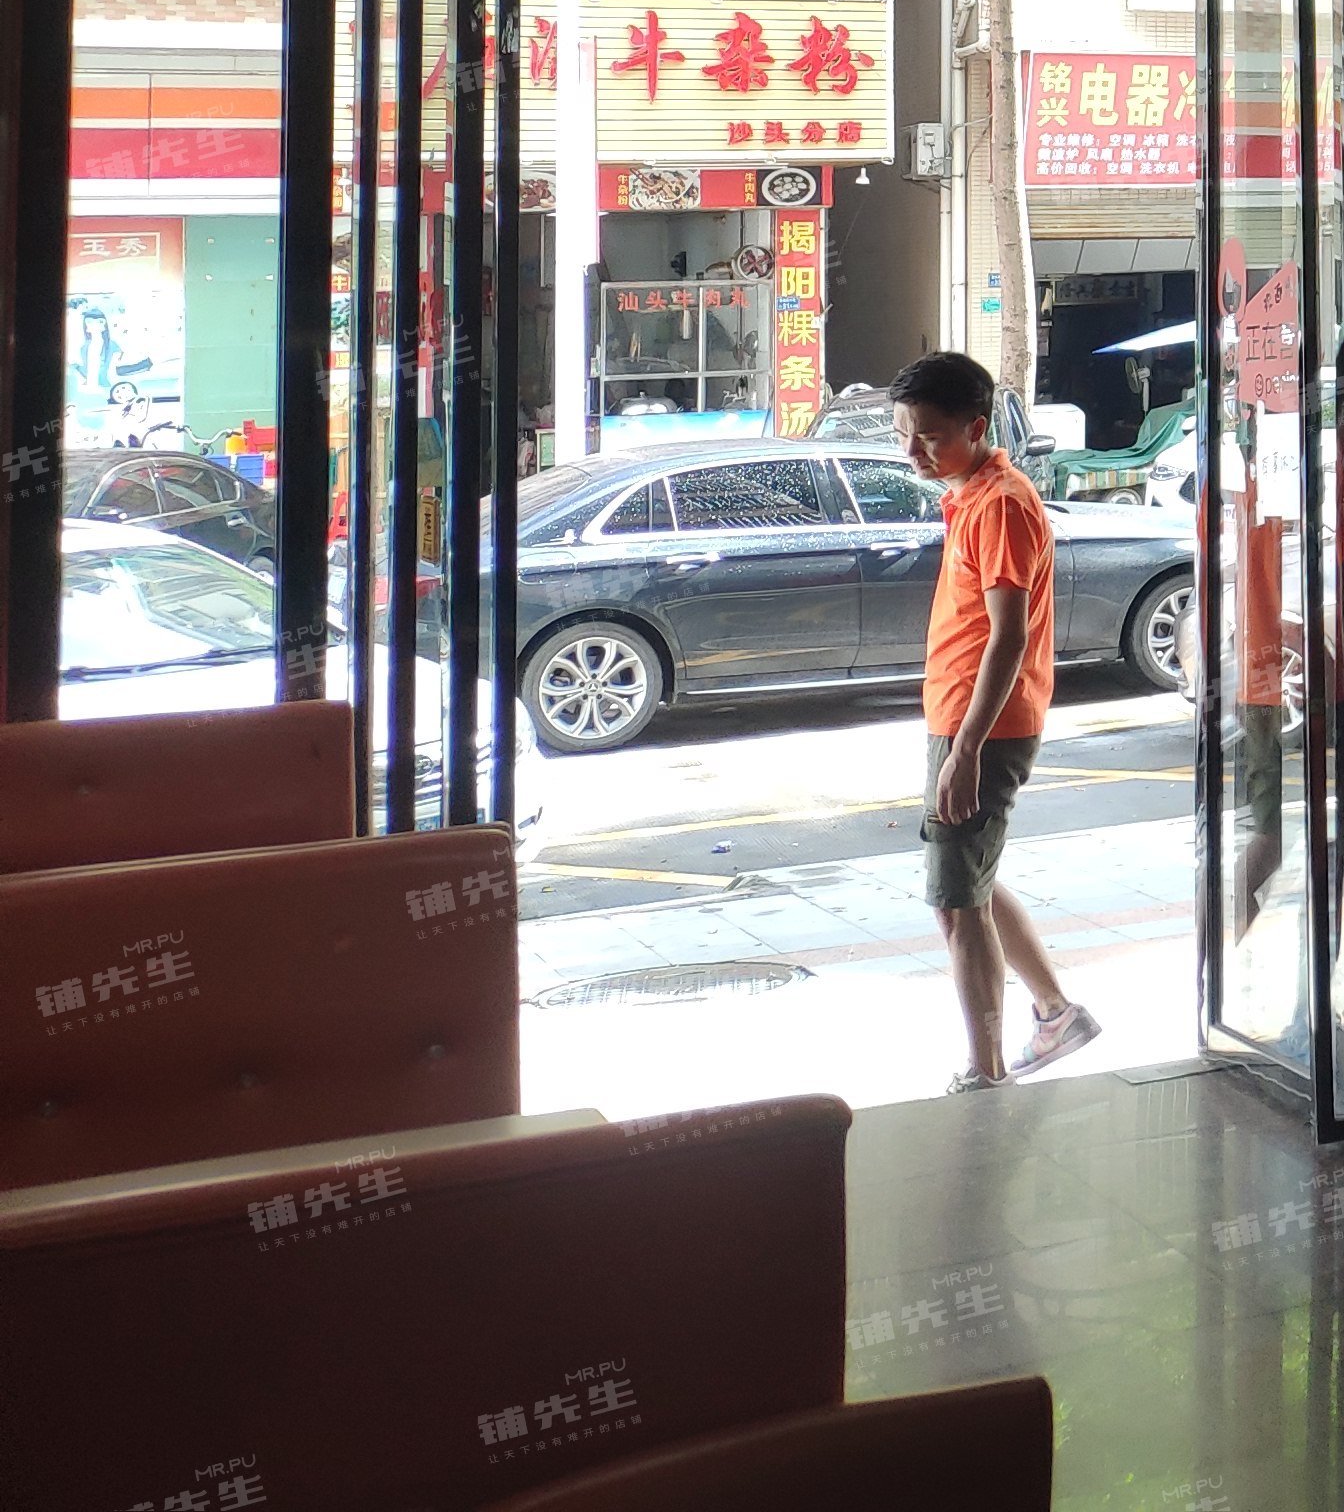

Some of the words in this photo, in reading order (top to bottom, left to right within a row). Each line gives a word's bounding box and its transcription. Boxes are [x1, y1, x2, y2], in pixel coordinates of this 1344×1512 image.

[726, 121, 863, 145] 沙头分店
[744, 171, 755, 204] 牛肉丸
[616, 289, 752, 313] 汕头牛肉丸
[777, 220, 817, 437] 揭阳粿条汤
